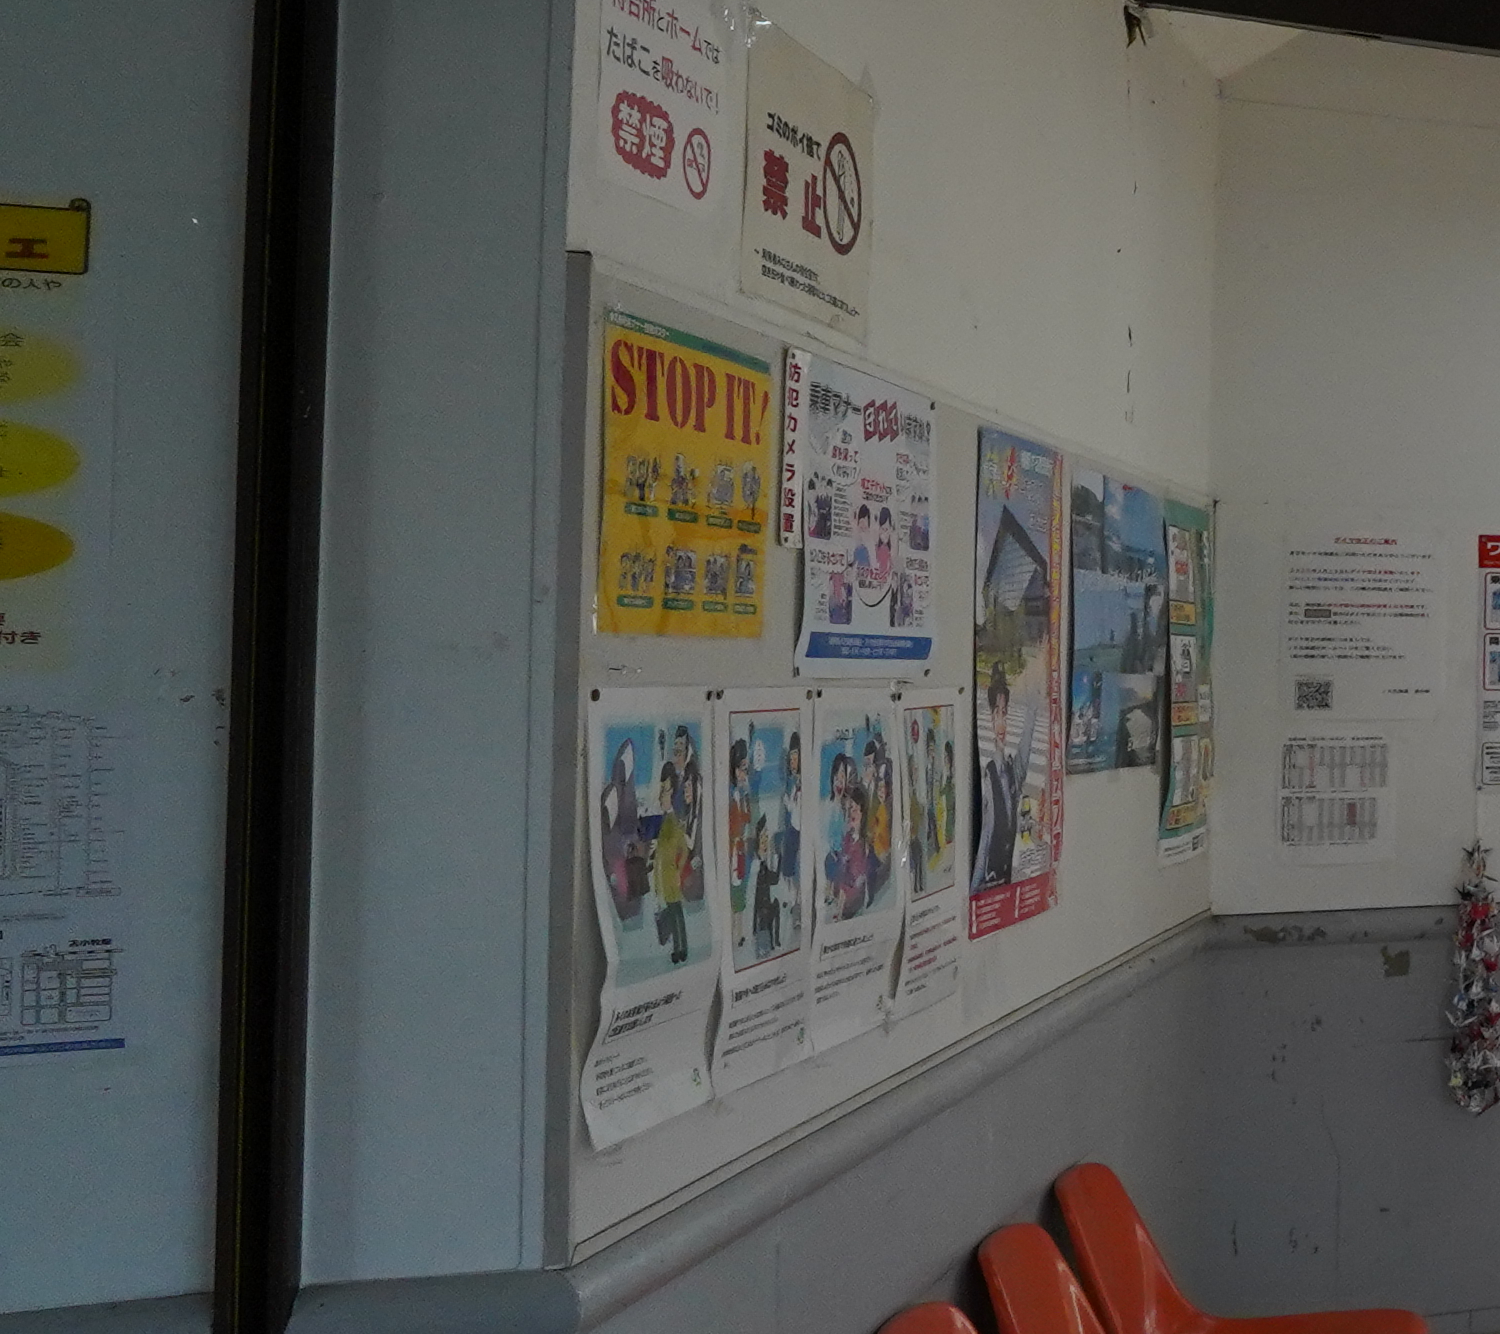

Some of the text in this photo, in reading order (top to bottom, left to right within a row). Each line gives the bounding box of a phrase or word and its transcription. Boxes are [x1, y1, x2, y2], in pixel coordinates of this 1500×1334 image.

[616, 99, 668, 169] 禁煙
[765, 111, 823, 164] ゴミのポイ捨て
[761, 148, 823, 240] 禁止
[611, 339, 770, 447] STOP IT!
[781, 362, 802, 534] 防犯カメラ設置
